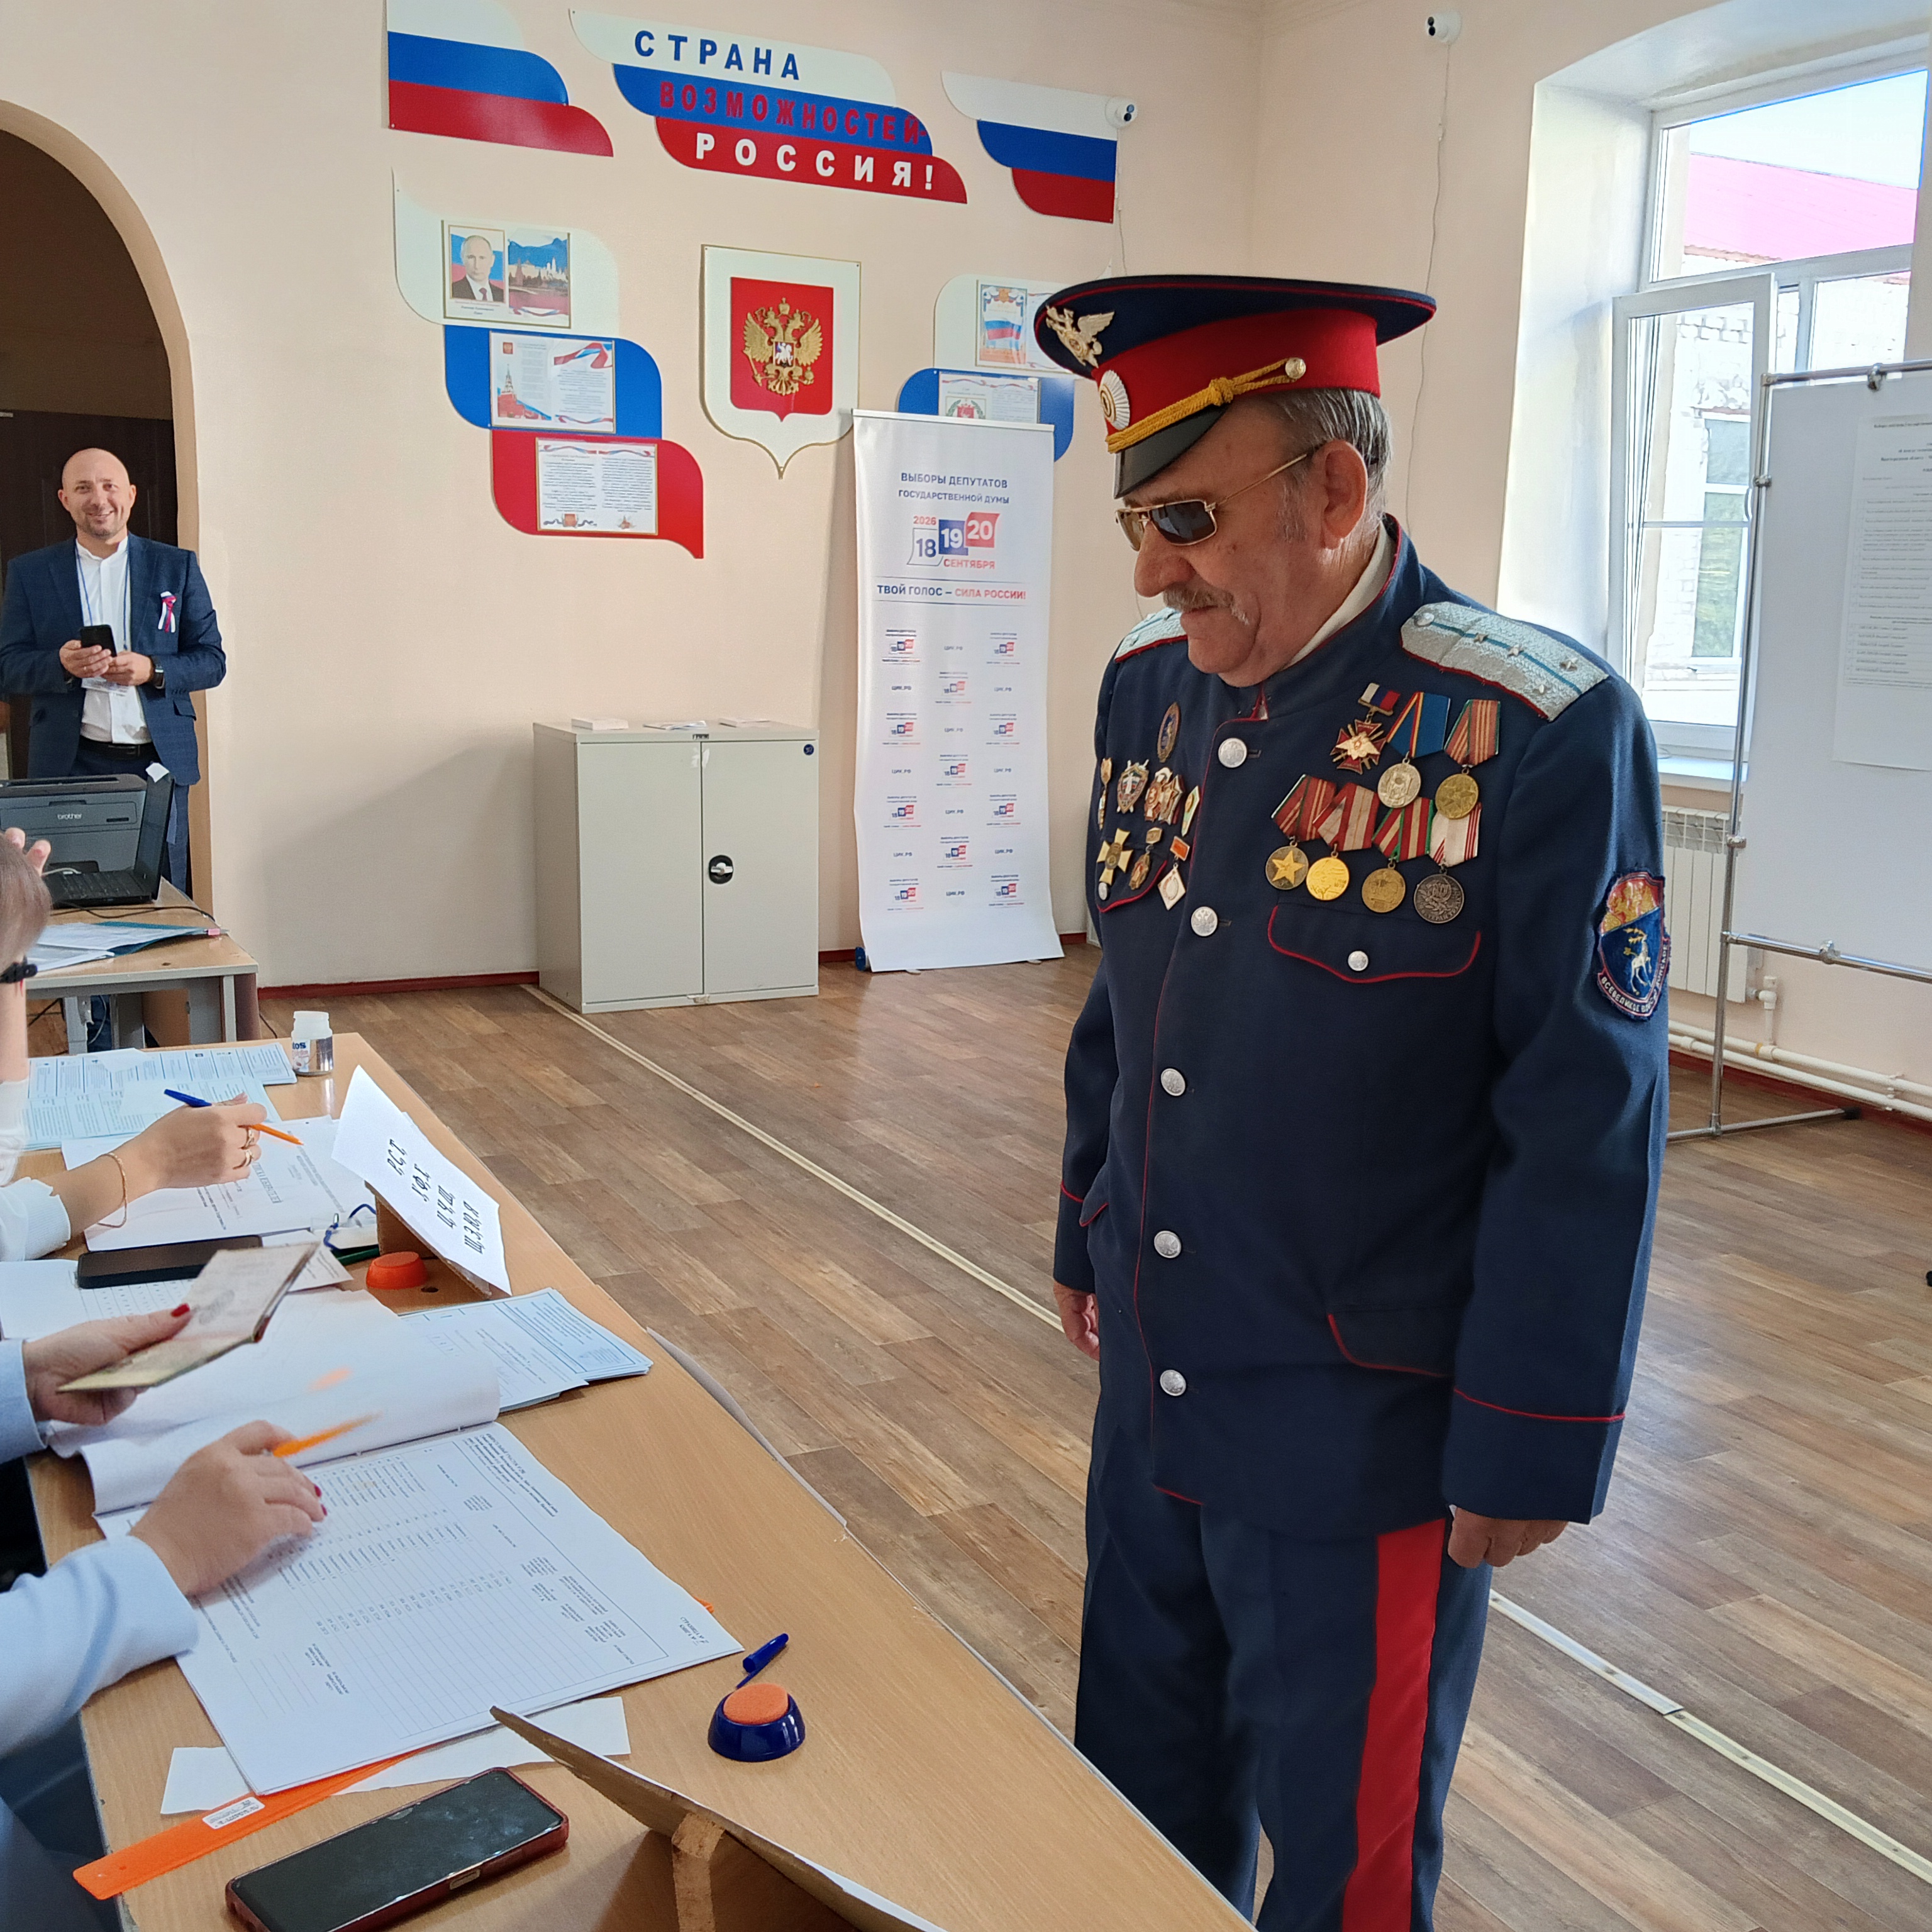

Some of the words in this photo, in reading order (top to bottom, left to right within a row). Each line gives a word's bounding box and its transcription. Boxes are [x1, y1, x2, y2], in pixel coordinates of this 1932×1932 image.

[635, 30, 799, 80] СТРАНА
[696, 132, 933, 190] РОССИЯ!
[901, 472, 946, 484] ВЫБОРЫ
[948, 476, 1008, 488] ДЕПУТАТОВ
[898, 489, 982, 502] ГОСУДАРСТВЕННОЙ
[984, 496, 1009, 504] ДУМЫ
[913, 515, 936, 526] 2026
[940, 528, 963, 548] 19
[967, 520, 993, 540] 20
[915, 538, 936, 558] 18
[943, 558, 995, 569] СЕНТЯБРЯ
[877, 584, 906, 595] ТВОЙ
[908, 586, 943, 596] ГОЛОС
[955, 588, 982, 598] СИЛА
[984, 589, 1026, 599] РОССИИ!
[1601, 977, 1640, 1013] ВСЕВЕЛИКОЕ
[464, 1201, 477, 1217] Я
